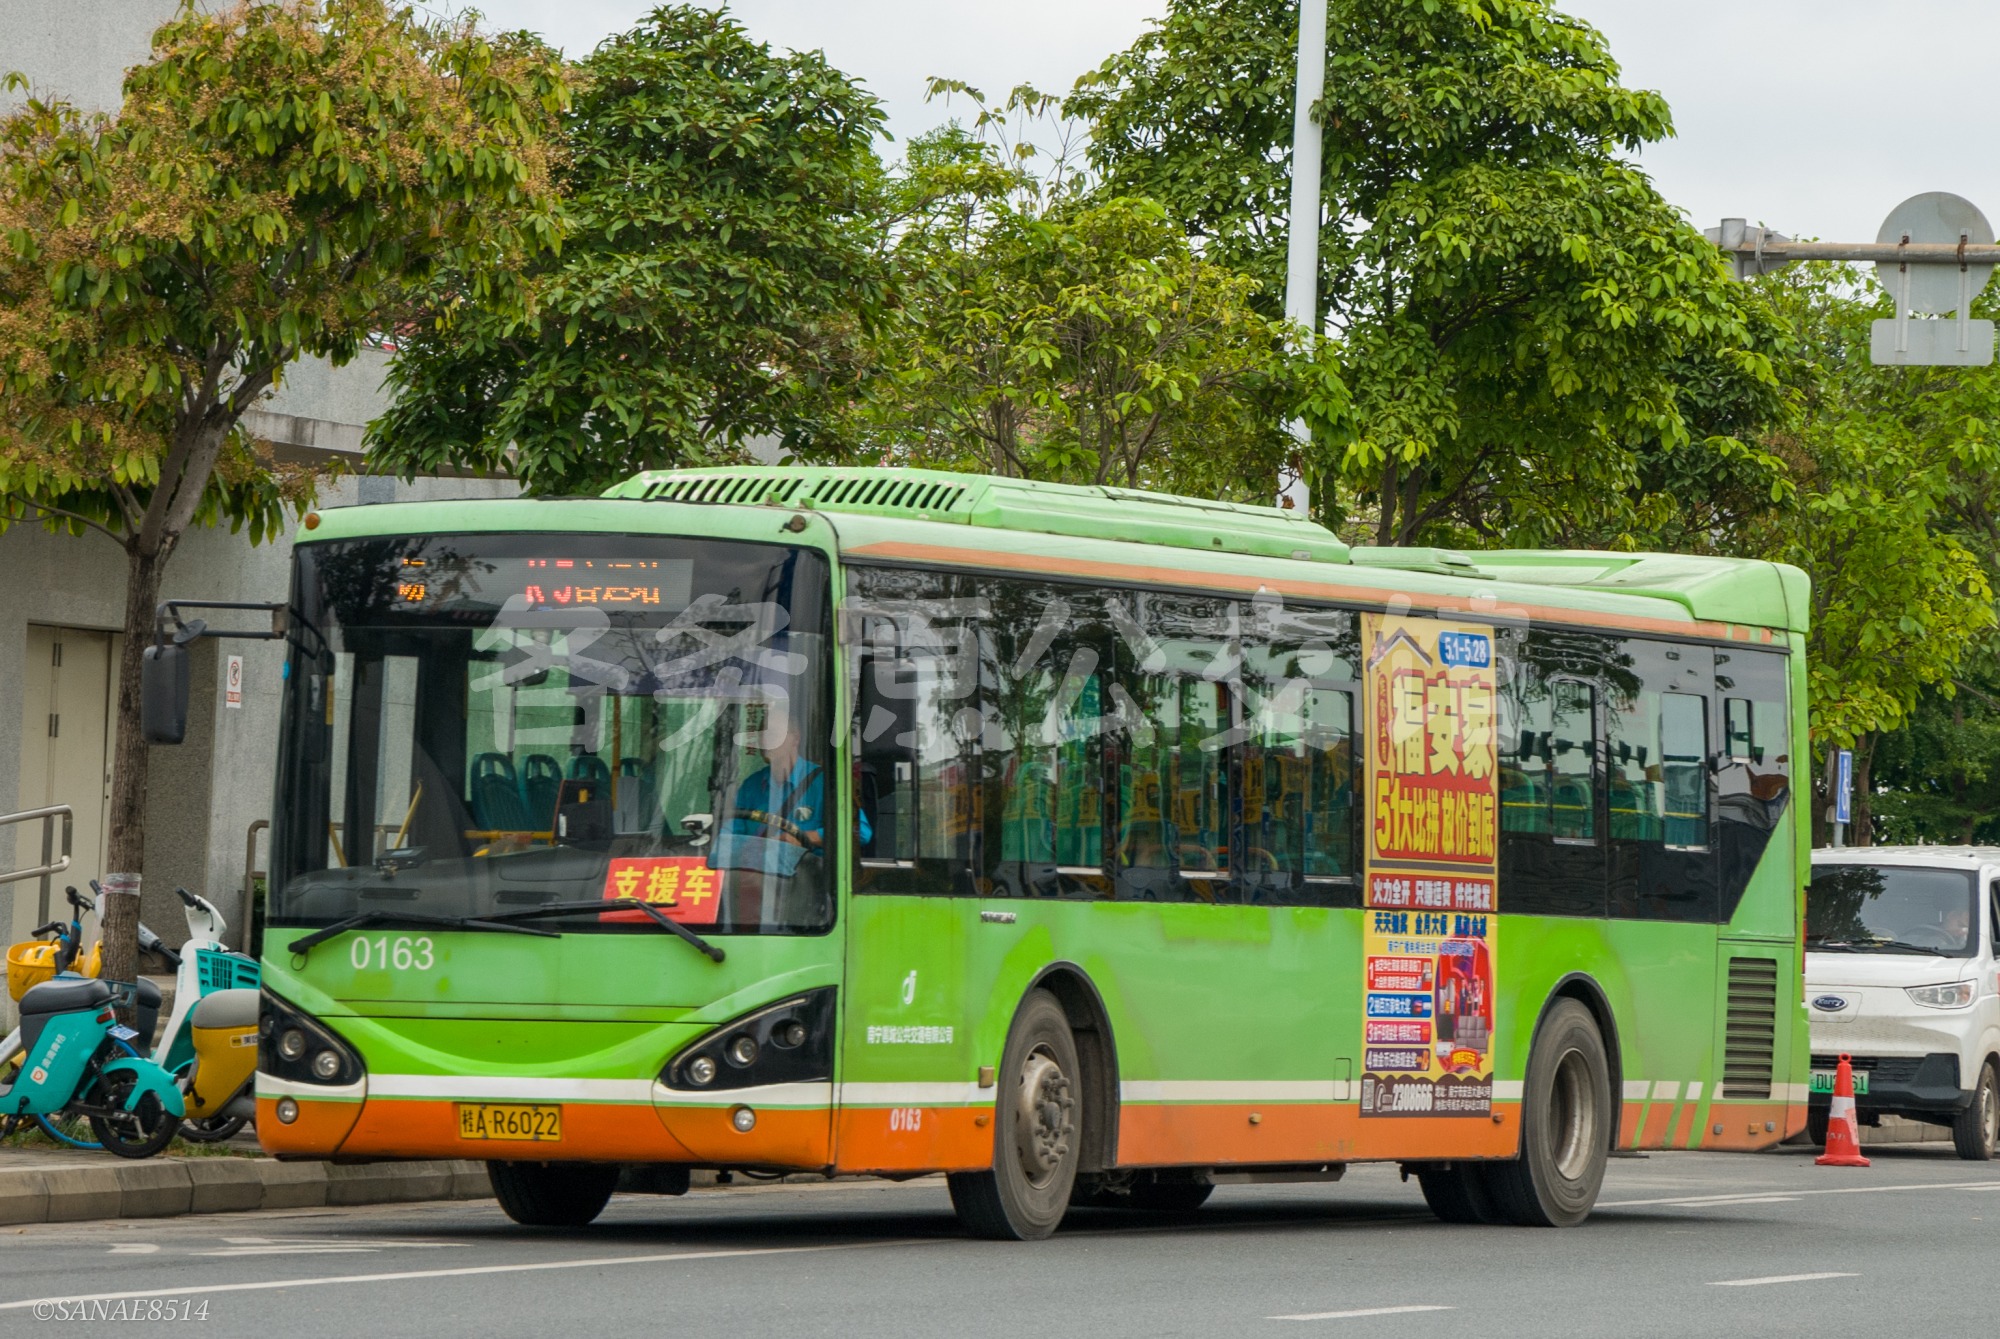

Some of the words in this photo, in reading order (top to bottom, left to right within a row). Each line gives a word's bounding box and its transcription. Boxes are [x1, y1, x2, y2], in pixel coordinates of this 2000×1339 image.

[1444, 637, 1487, 664] 5.1-5.28
[1391, 674, 1493, 780] 福安家
[1441, 789, 1494, 858] 放价到底
[613, 866, 719, 907] 支援车
[1373, 878, 1411, 906] 火力全开
[350, 937, 436, 972] 0163
[890, 1107, 921, 1132] 0163
